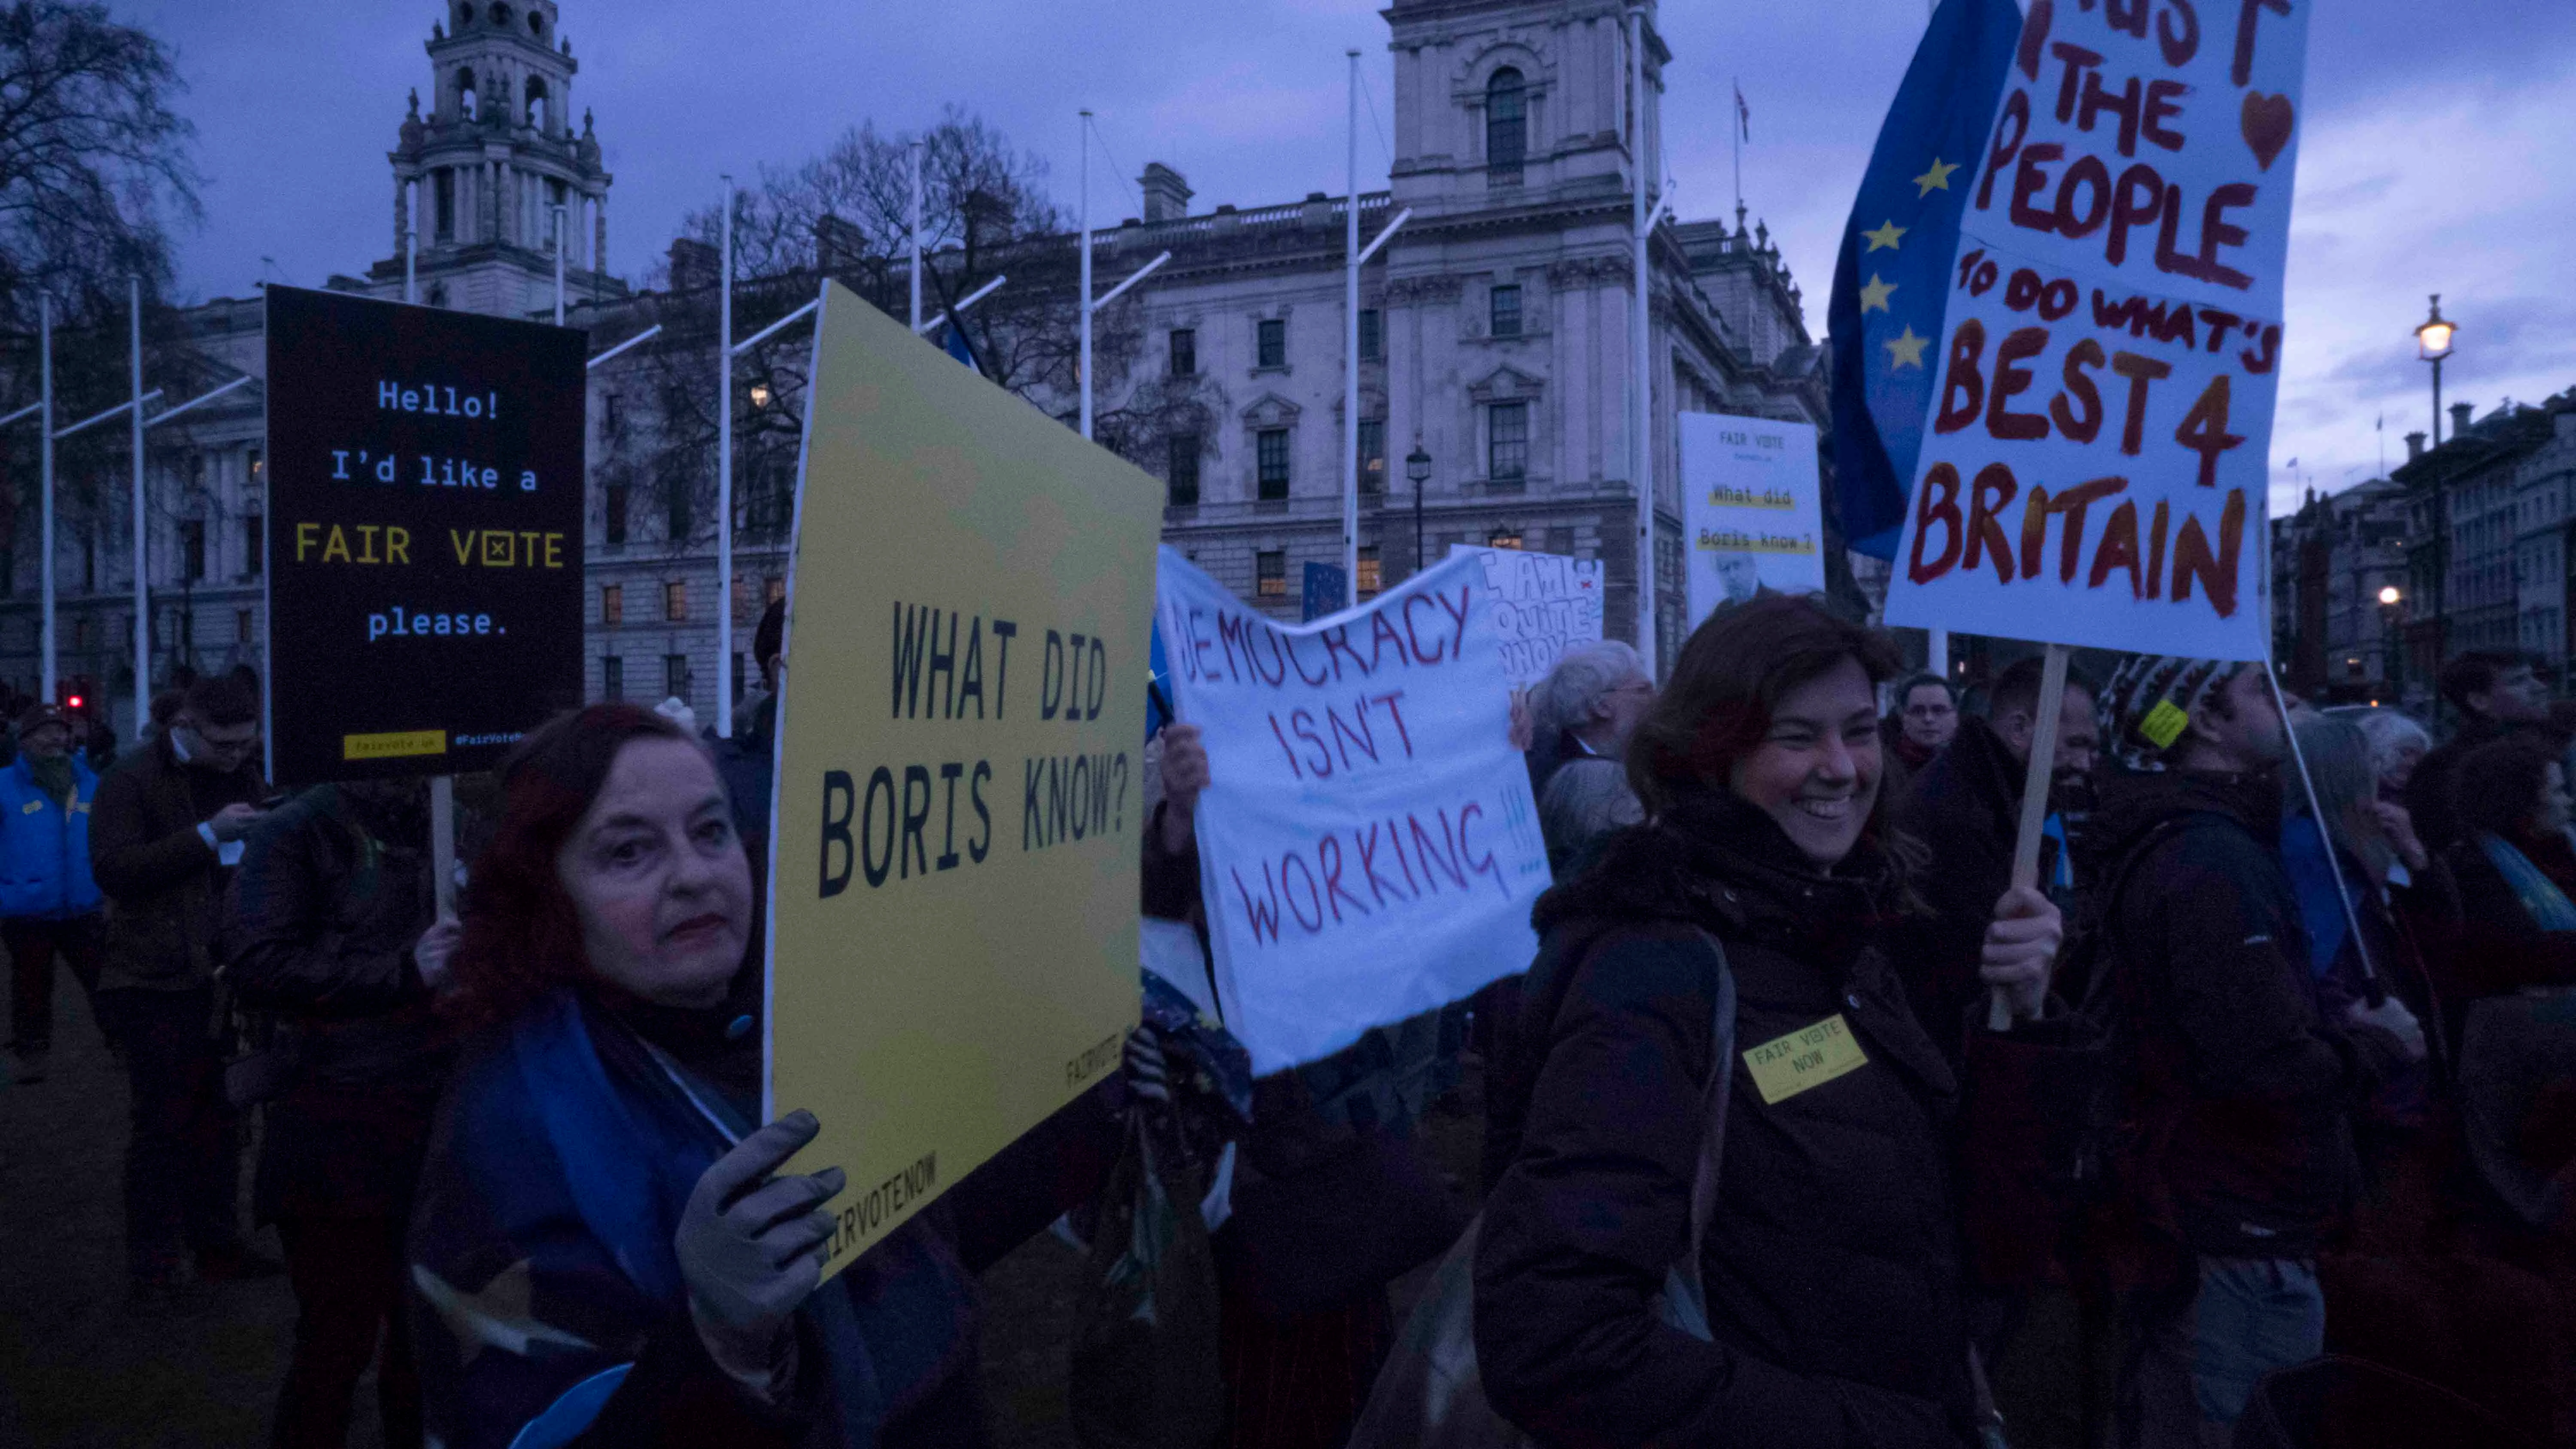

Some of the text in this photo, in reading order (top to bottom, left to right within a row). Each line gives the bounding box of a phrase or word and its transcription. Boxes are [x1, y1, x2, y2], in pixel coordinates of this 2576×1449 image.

[2018, 0, 2291, 87] UST
[2051, 42, 2187, 157] THE
[1976, 88, 2258, 291] PEOPLE
[1959, 248, 2280, 374] TO DO WHAT'S
[378, 380, 497, 420] Hello!
[1934, 318, 2246, 488] BEST 4
[331, 450, 537, 491] I'd like a
[1713, 483, 1791, 505] What did
[296, 522, 410, 564] FAIR
[1515, 553, 1568, 600] AM
[1701, 528, 1750, 546] Boris
[1908, 462, 2246, 620] BRITAIN
[369, 606, 506, 641] please.
[892, 601, 1106, 721] WHAT DID
[1171, 586, 1471, 688] DEMOCRACY
[1493, 596, 1590, 640] QUITE
[1268, 689, 1413, 780] ISN'T
[819, 752, 1128, 898] BORIS KNOW?
[1754, 1040, 1792, 1064] FAIR
[1792, 1049, 1824, 1073] NOW
[827, 1150, 936, 1258] IRVOTENOW
